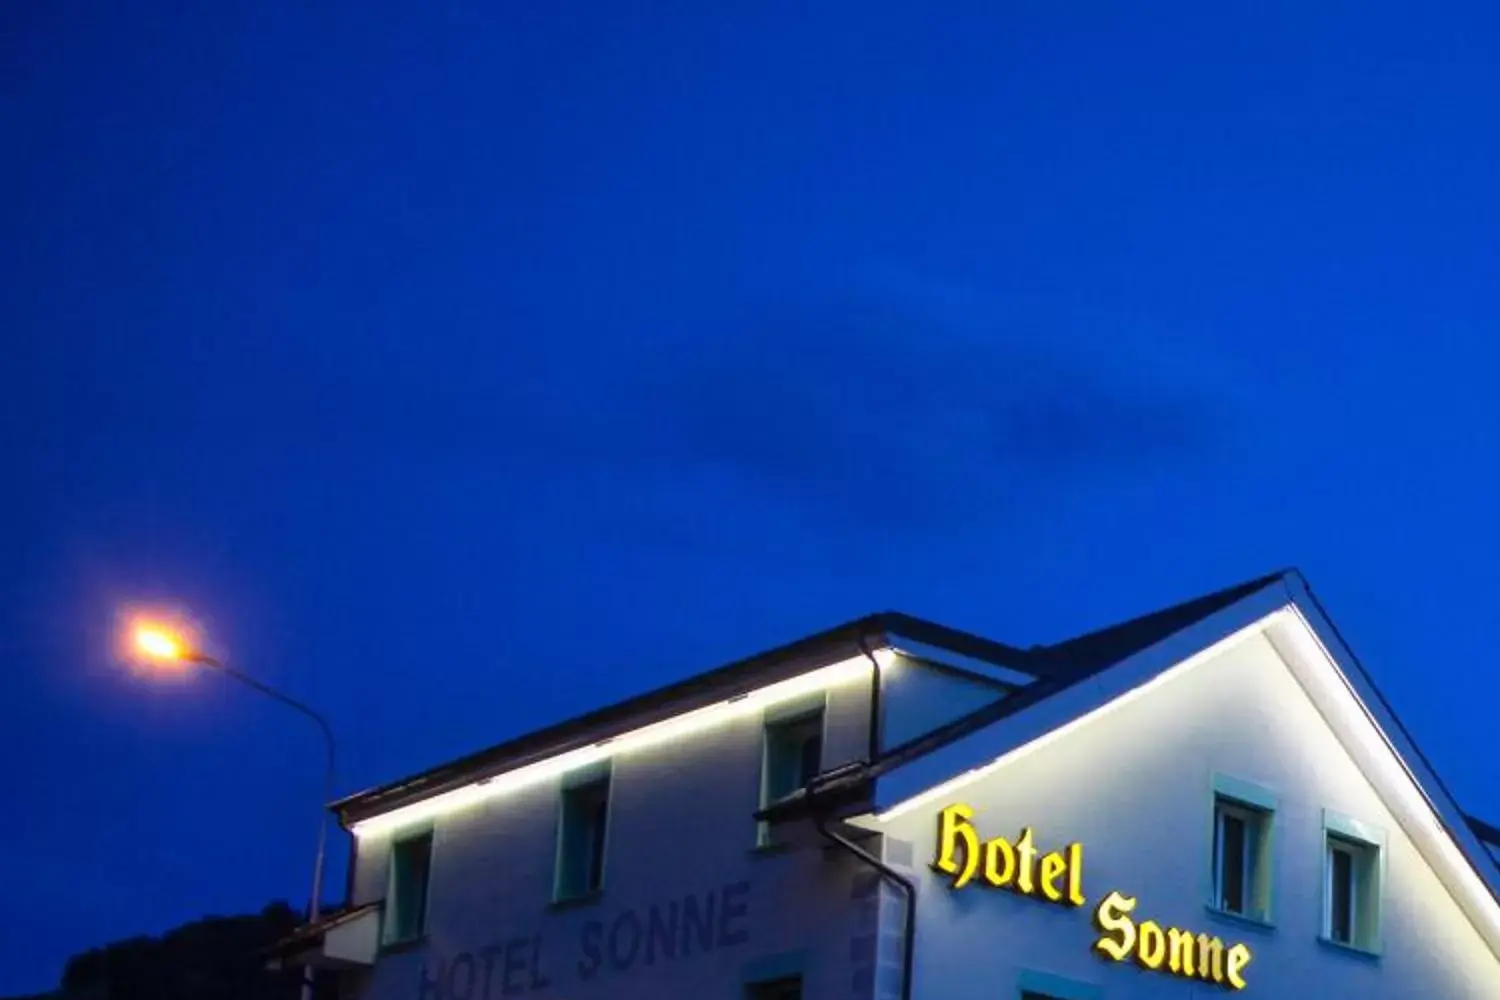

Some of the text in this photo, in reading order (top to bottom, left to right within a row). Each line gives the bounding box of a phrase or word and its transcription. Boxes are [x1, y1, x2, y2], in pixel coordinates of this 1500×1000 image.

[935, 803, 1085, 907] Hotel
[577, 881, 750, 981] SONNE
[1095, 891, 1251, 990] Sonne
